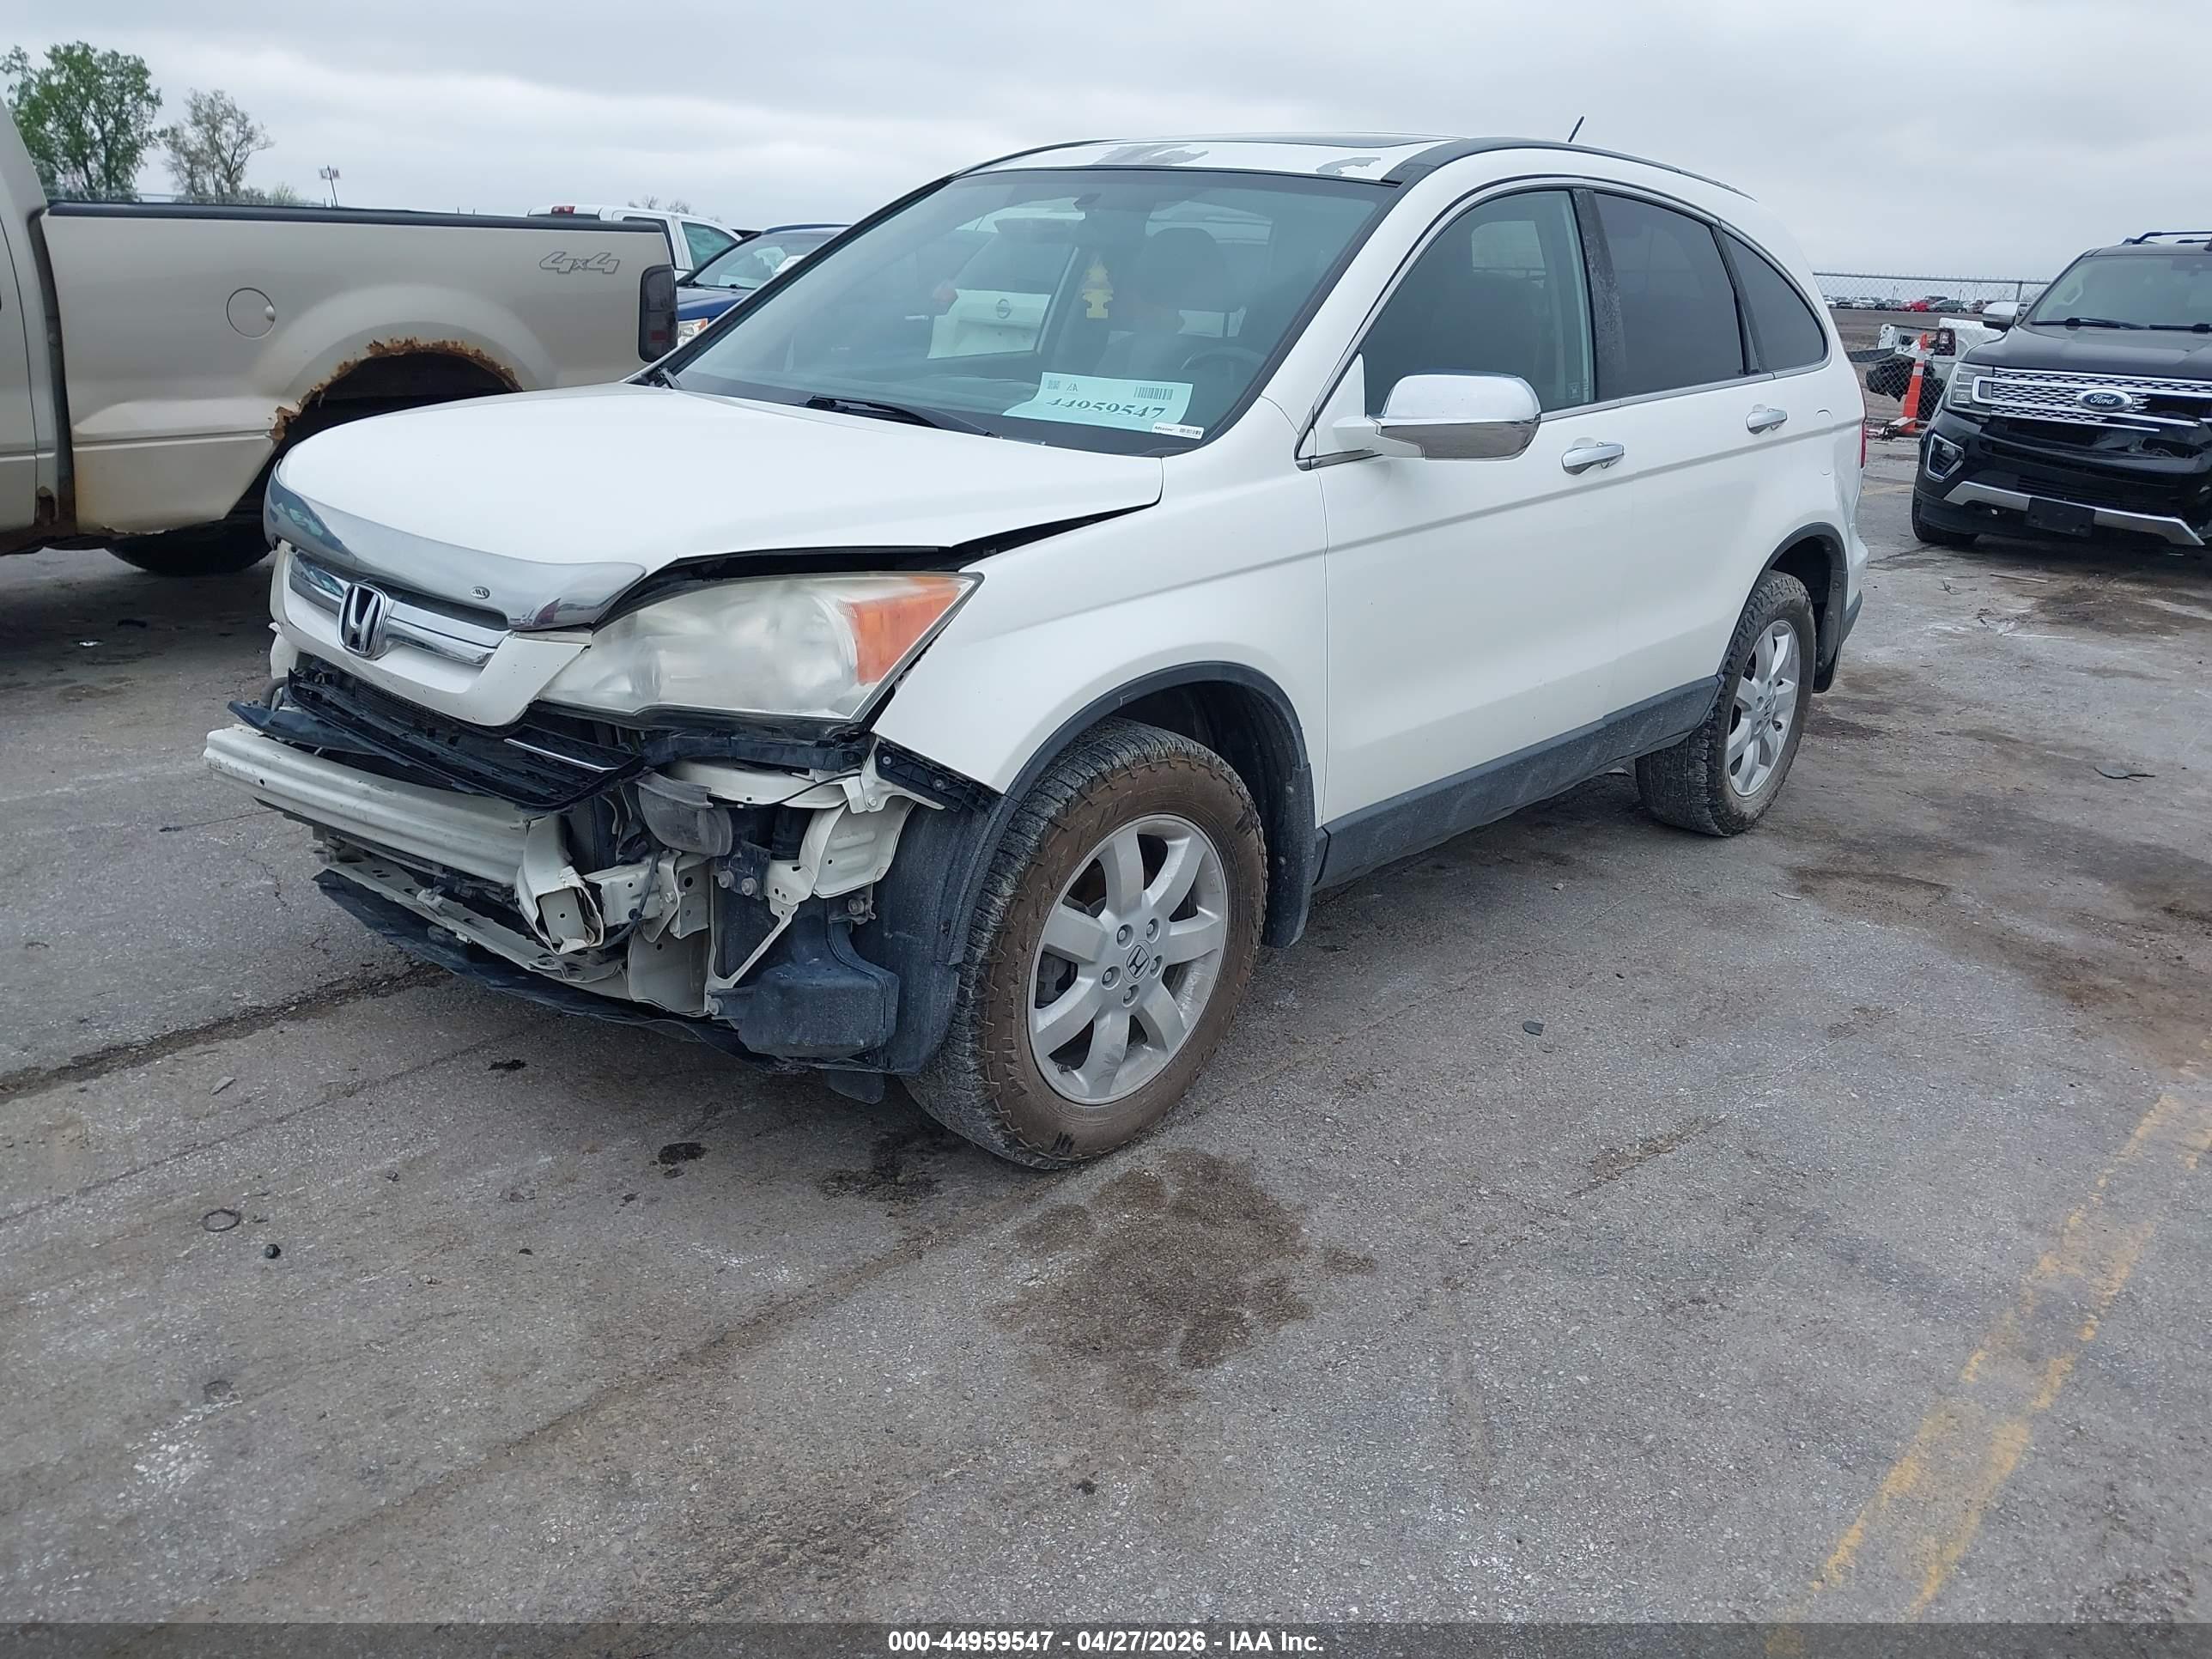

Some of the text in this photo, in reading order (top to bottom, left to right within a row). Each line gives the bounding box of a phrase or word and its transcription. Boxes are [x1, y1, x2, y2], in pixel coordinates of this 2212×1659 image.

[538, 251, 620, 275] 4x4
[1046, 398, 1166, 419] 44959547
[2089, 393, 2117, 405] Ford
